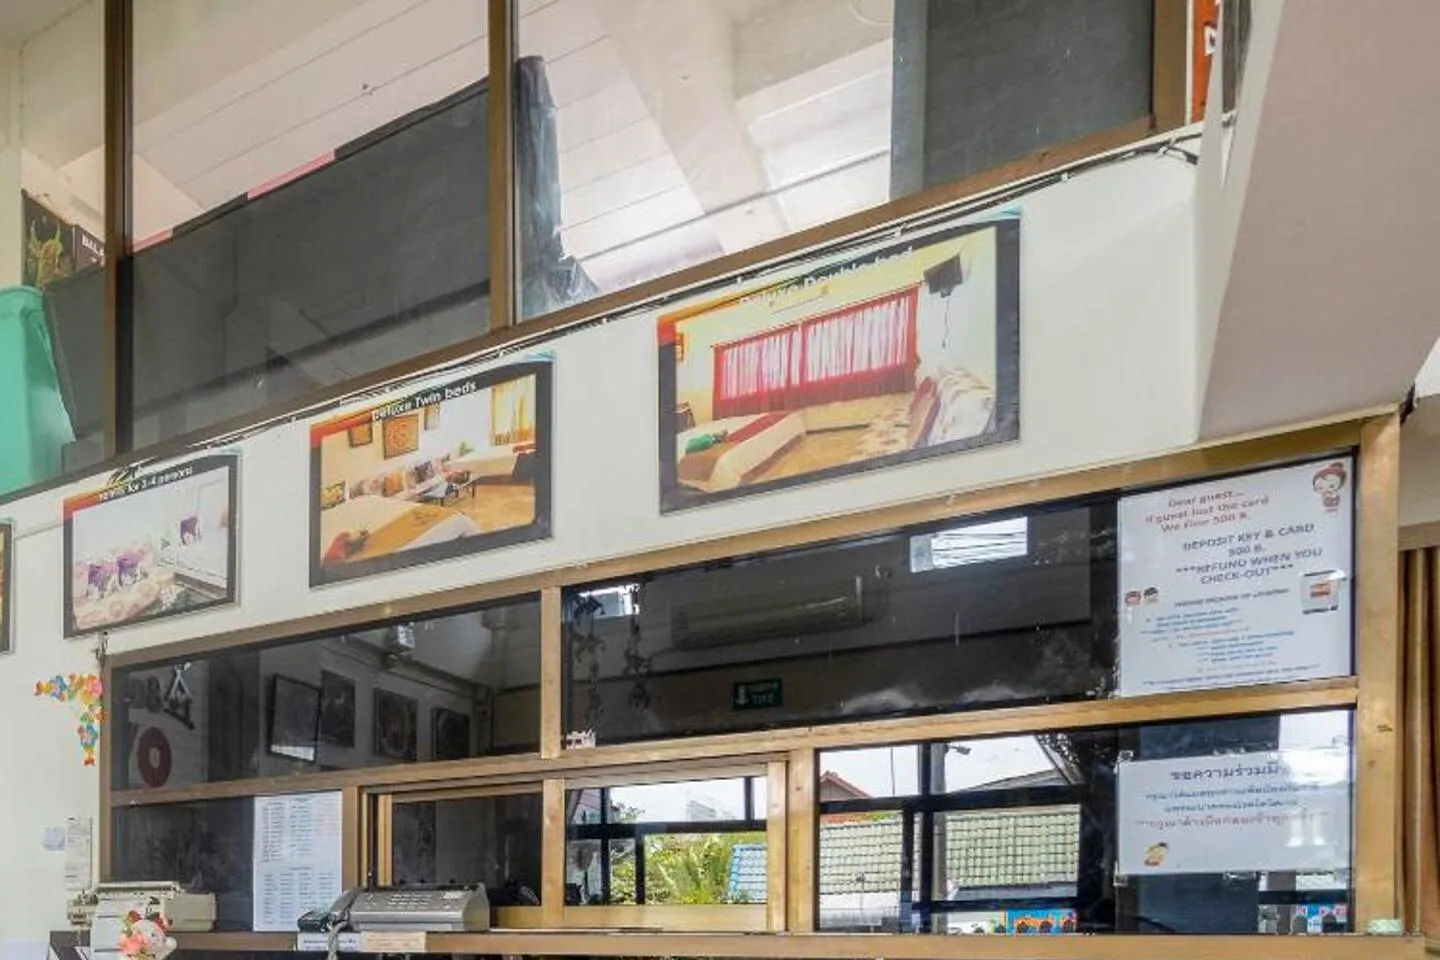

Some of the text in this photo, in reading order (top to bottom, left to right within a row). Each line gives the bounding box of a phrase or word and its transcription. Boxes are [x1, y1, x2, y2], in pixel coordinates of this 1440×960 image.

[415, 391, 442, 407] Twin
[444, 380, 477, 399] beds
[1183, 534, 1234, 551] DEPOSIT
[1238, 530, 1261, 543] KEY
[1278, 523, 1315, 538] CARD
[1251, 552, 1291, 567] WHEN
[1294, 548, 1323, 561] YOU
